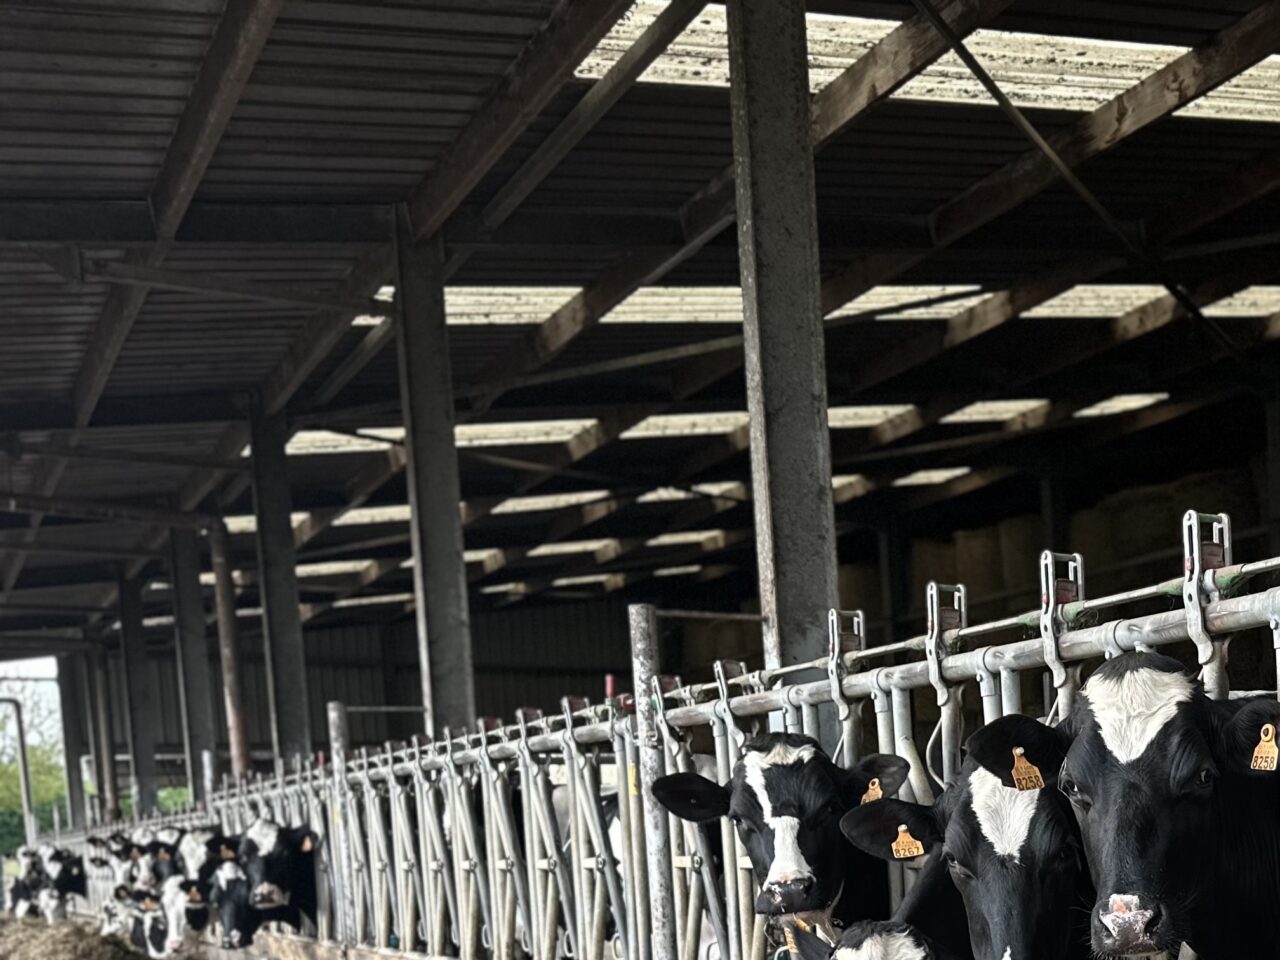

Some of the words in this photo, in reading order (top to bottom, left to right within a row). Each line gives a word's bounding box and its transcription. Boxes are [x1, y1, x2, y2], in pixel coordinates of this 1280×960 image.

[1252, 755, 1275, 769] 8258
[1016, 775, 1043, 790] 8258
[894, 846, 920, 857] 8267
